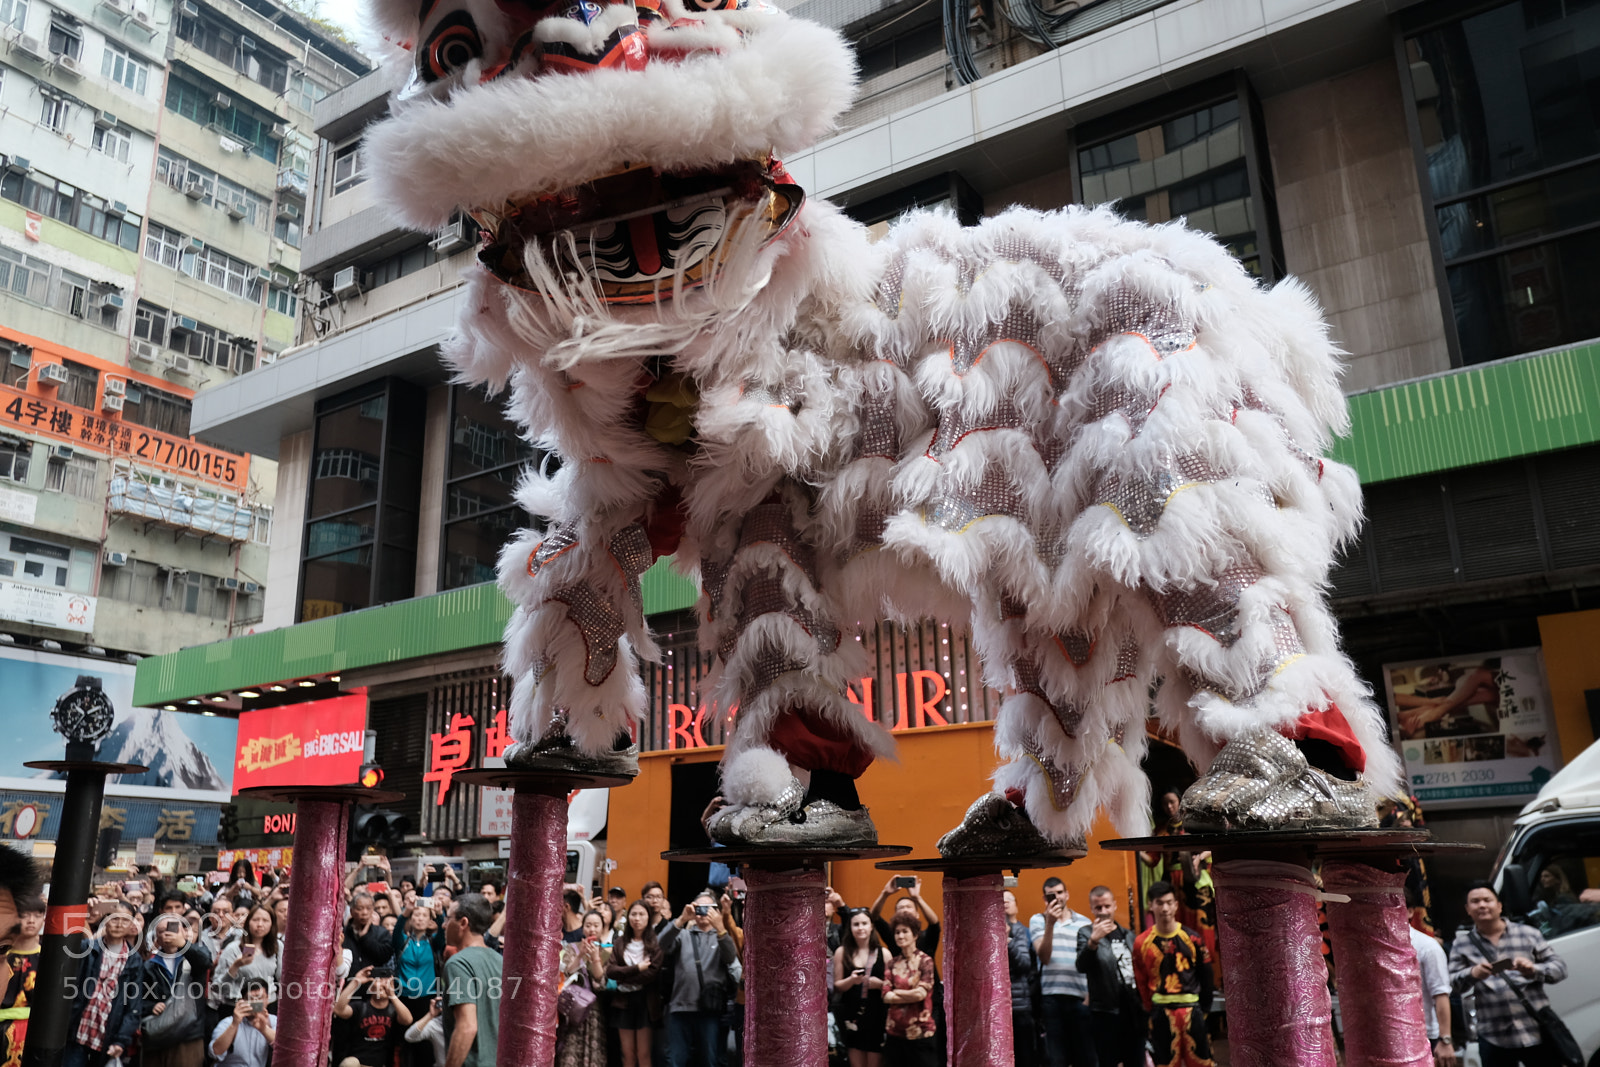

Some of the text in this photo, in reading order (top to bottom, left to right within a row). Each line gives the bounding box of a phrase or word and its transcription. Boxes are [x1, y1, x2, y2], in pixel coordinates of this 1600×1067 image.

[6, 397, 73, 436] 4字樓
[136, 433, 237, 482] 27700155
[1426, 769, 1495, 785] 2781 2030
